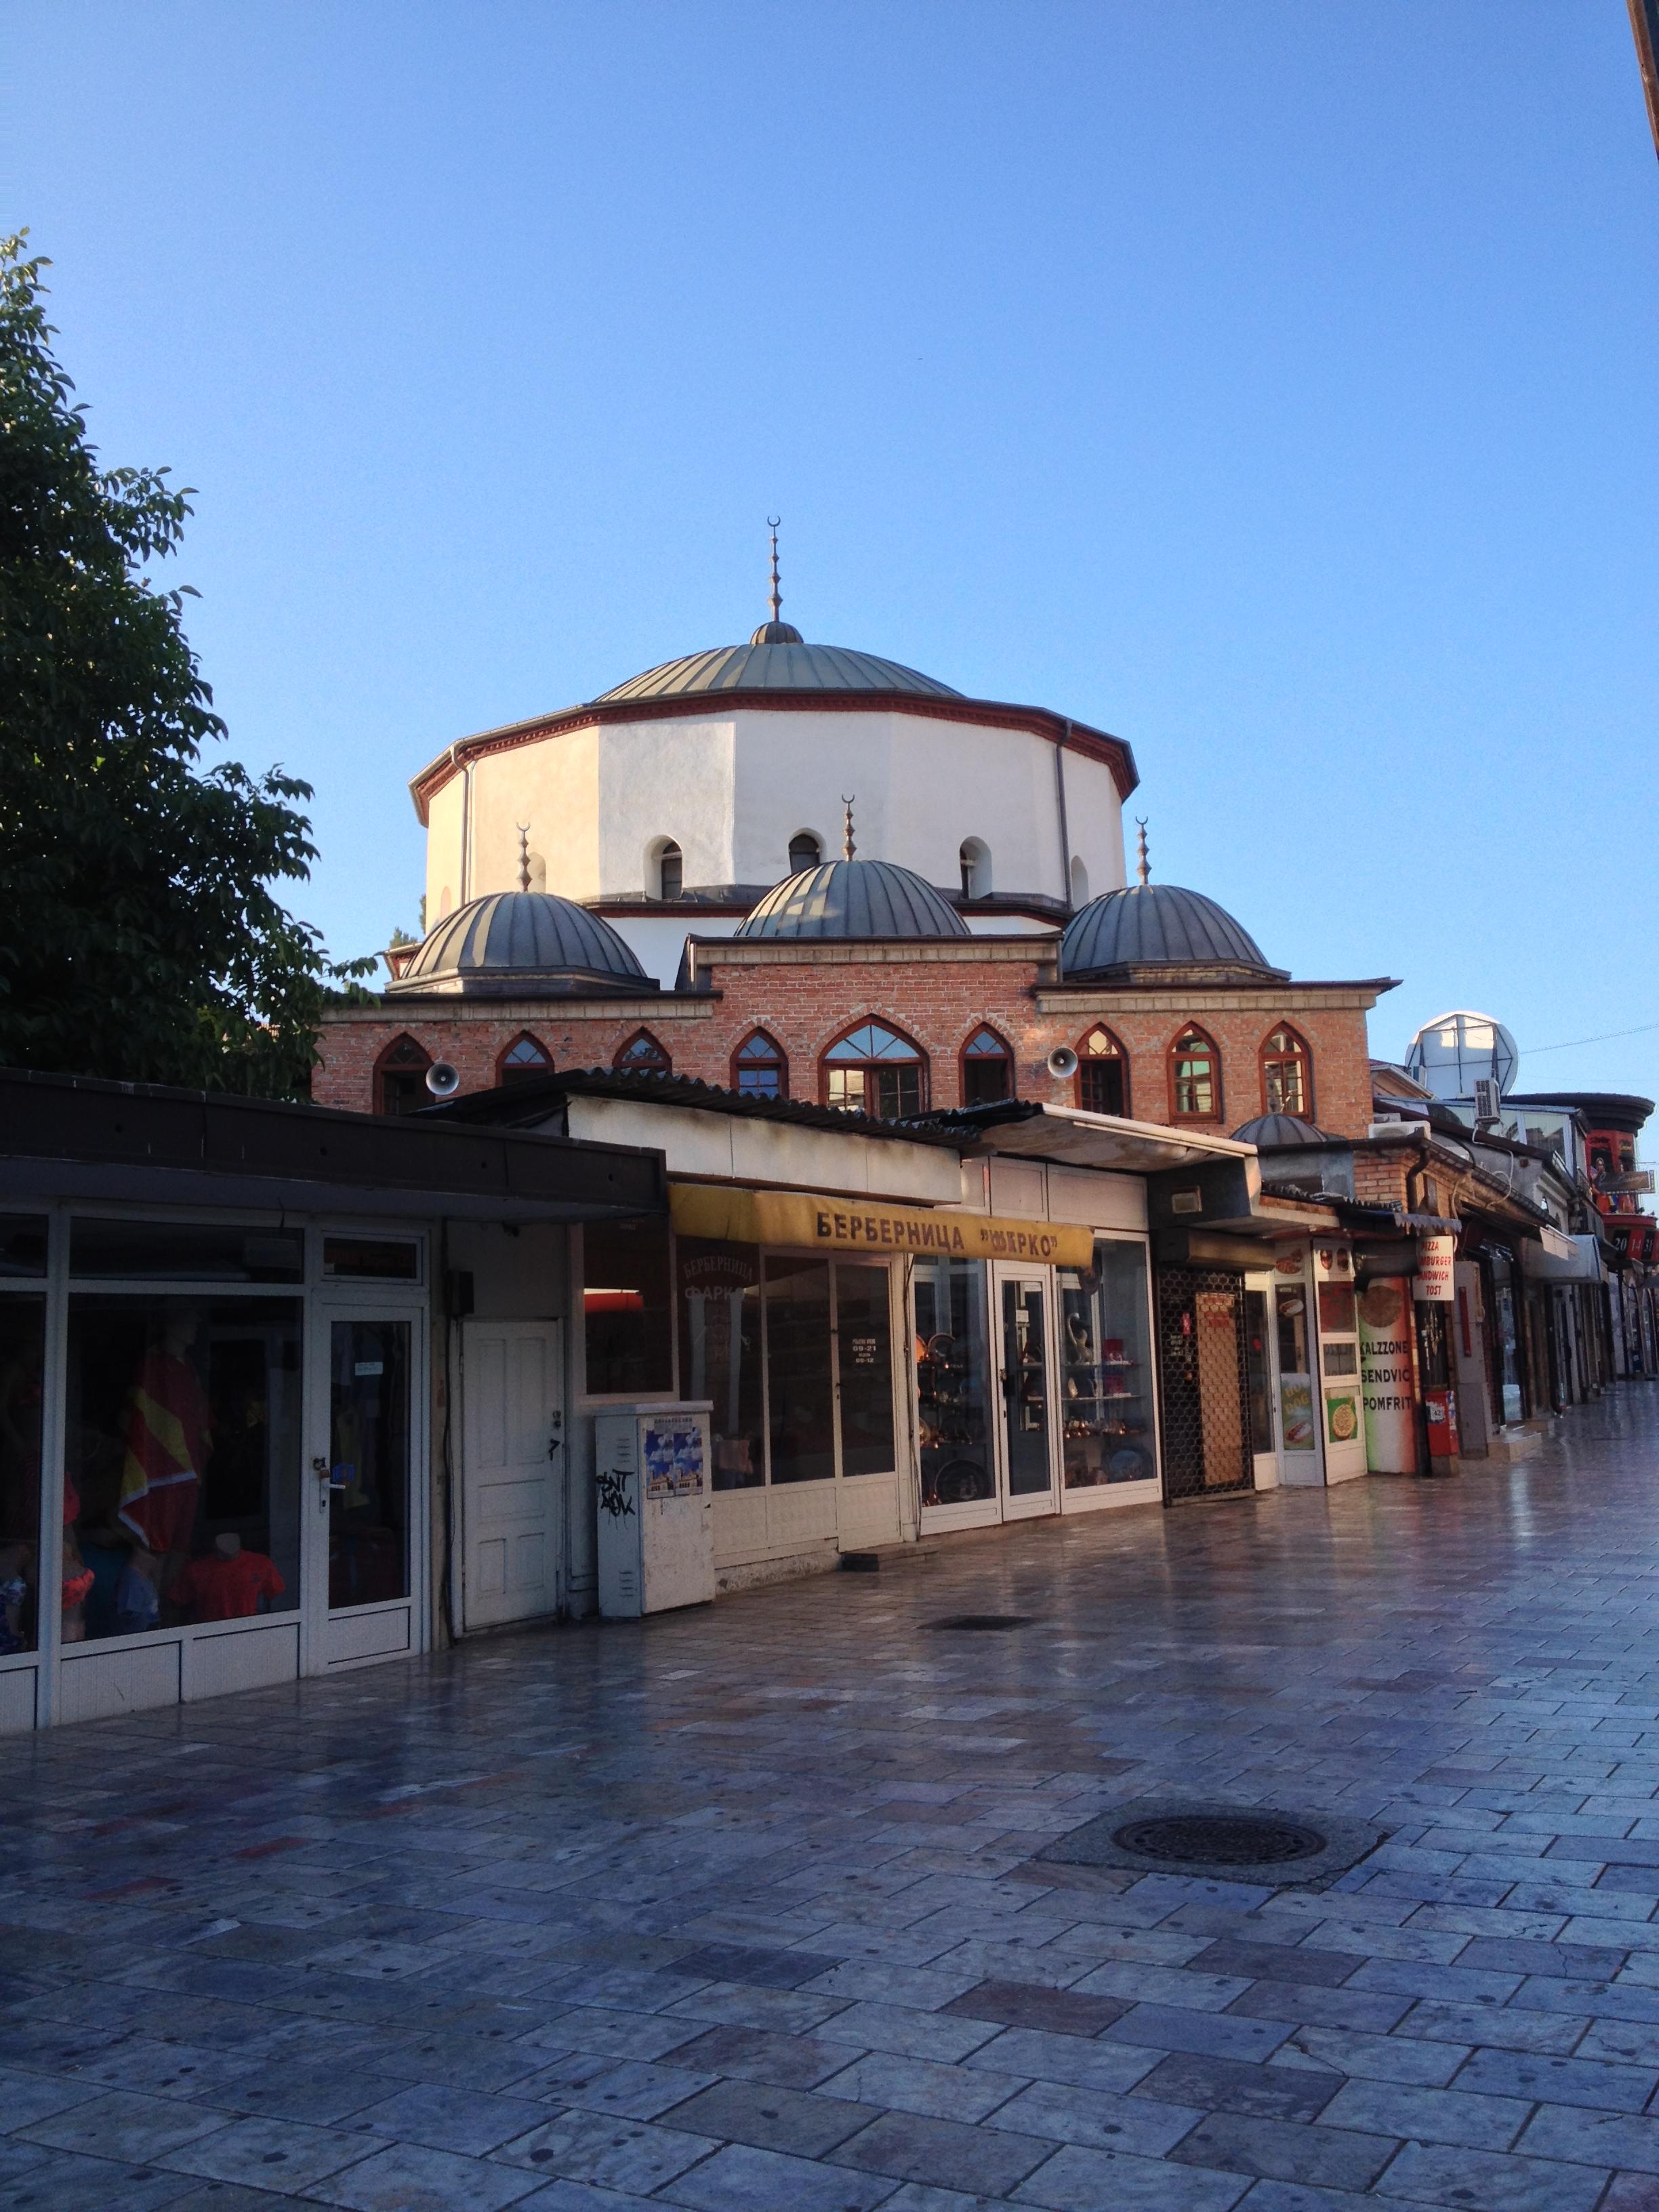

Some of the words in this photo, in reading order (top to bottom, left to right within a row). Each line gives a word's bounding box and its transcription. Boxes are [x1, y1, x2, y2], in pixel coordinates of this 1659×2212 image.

[817, 1211, 965, 1252] БЕРБЕРНИЦА
[1426, 1285, 1441, 1296] TOST
[1363, 1397, 1411, 1411] POMFRIT
